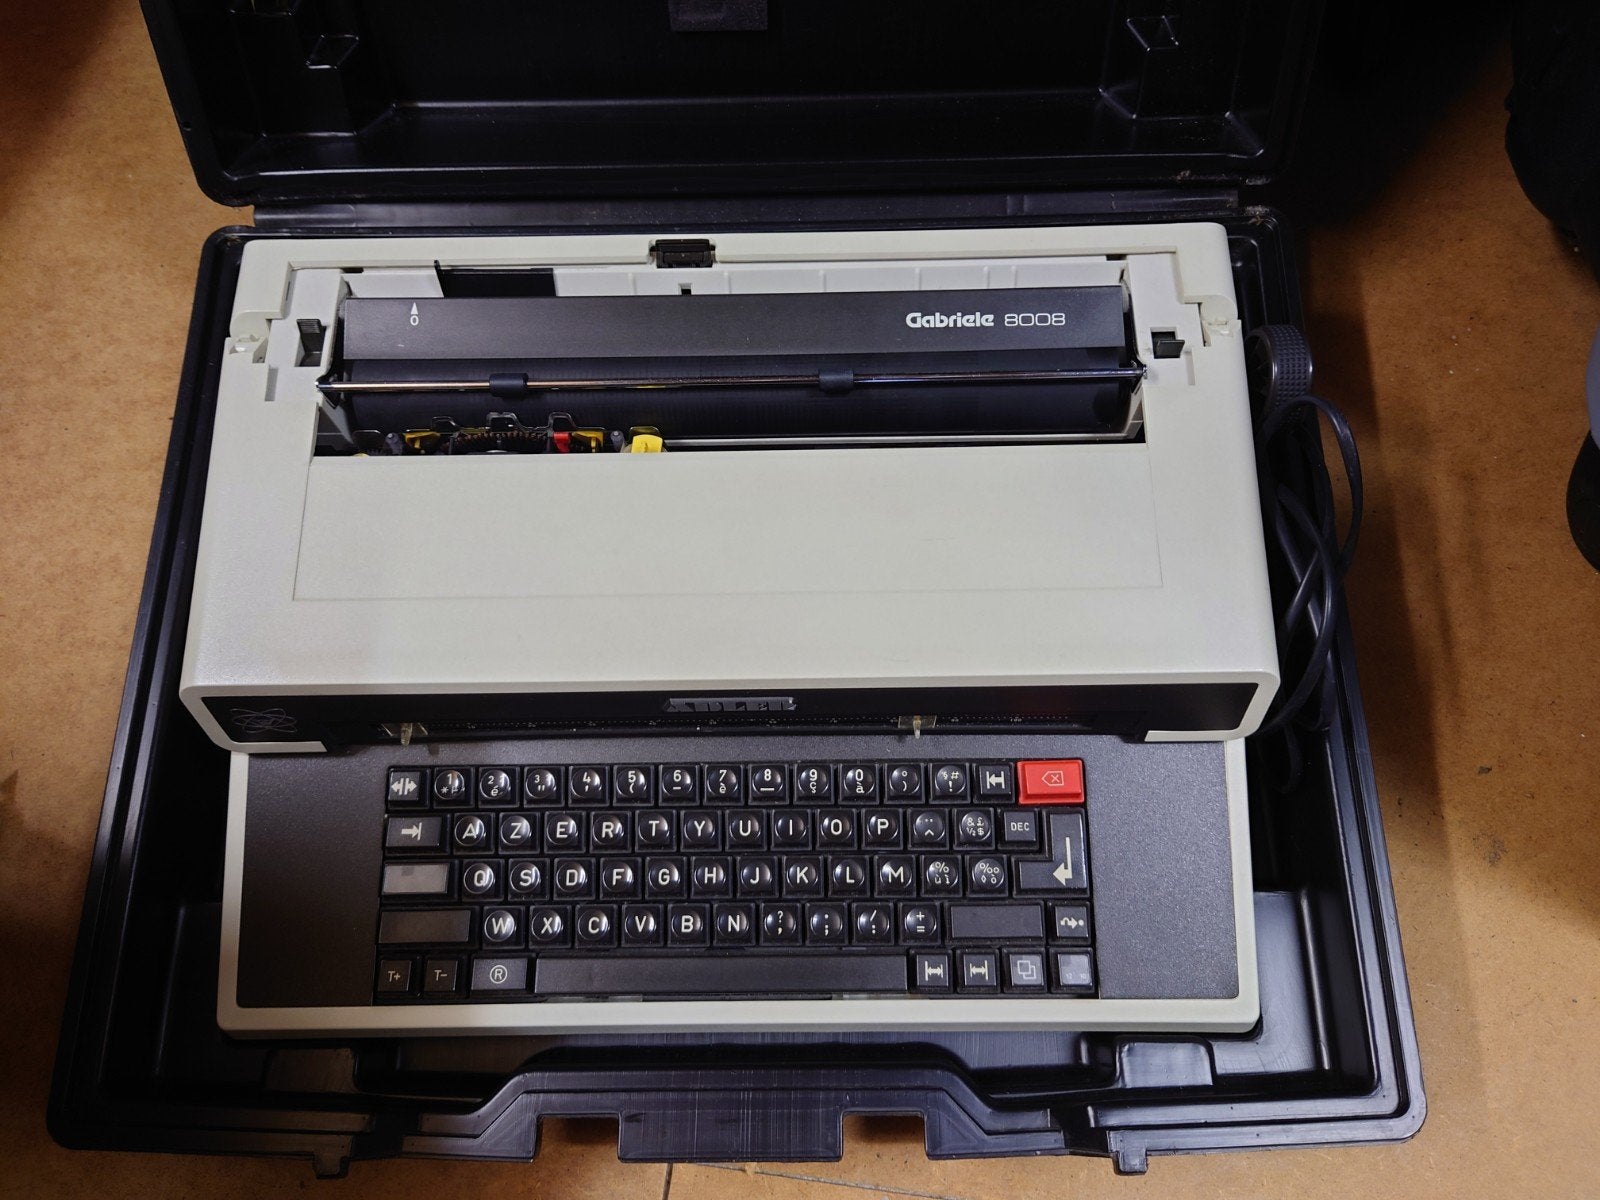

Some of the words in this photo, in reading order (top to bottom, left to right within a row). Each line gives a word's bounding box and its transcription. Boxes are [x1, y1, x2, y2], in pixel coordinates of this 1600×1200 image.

[906, 312, 994, 328] Gabriele
[1004, 313, 1066, 327] 8008
[447, 773, 452, 785] 1
[488, 775, 495, 784] 2
[534, 774, 540, 783] 3
[583, 772, 591, 783] 4
[628, 770, 636, 783] 5
[673, 770, 682, 782] 6
[719, 770, 727, 781] 7
[764, 768, 772, 781] 8
[809, 769, 818, 781] 9
[855, 769, 864, 781] 0
[491, 785, 499, 797] é
[462, 823, 477, 839] A
[510, 822, 522, 839] Z
[556, 821, 568, 838] E
[601, 821, 614, 838] R
[648, 820, 659, 837] T
[694, 820, 705, 837] Y
[739, 820, 751, 836] U
[830, 819, 842, 835] O
[877, 819, 889, 835] P
[1010, 821, 1030, 831] DEC
[473, 870, 486, 887] Q
[520, 869, 532, 887] S
[566, 869, 578, 886] D
[612, 868, 625, 886] F
[658, 868, 670, 885] G
[704, 867, 717, 884] H
[750, 867, 760, 884] J
[797, 866, 809, 884] K
[846, 866, 855, 883] L
[888, 866, 904, 883] M
[492, 917, 509, 935] W
[541, 917, 553, 934] X
[588, 917, 600, 934] C
[635, 915, 647, 932] V
[681, 915, 694, 933] B
[728, 915, 740, 932] N
[387, 970, 401, 982] T+
[434, 969, 447, 981] T-
